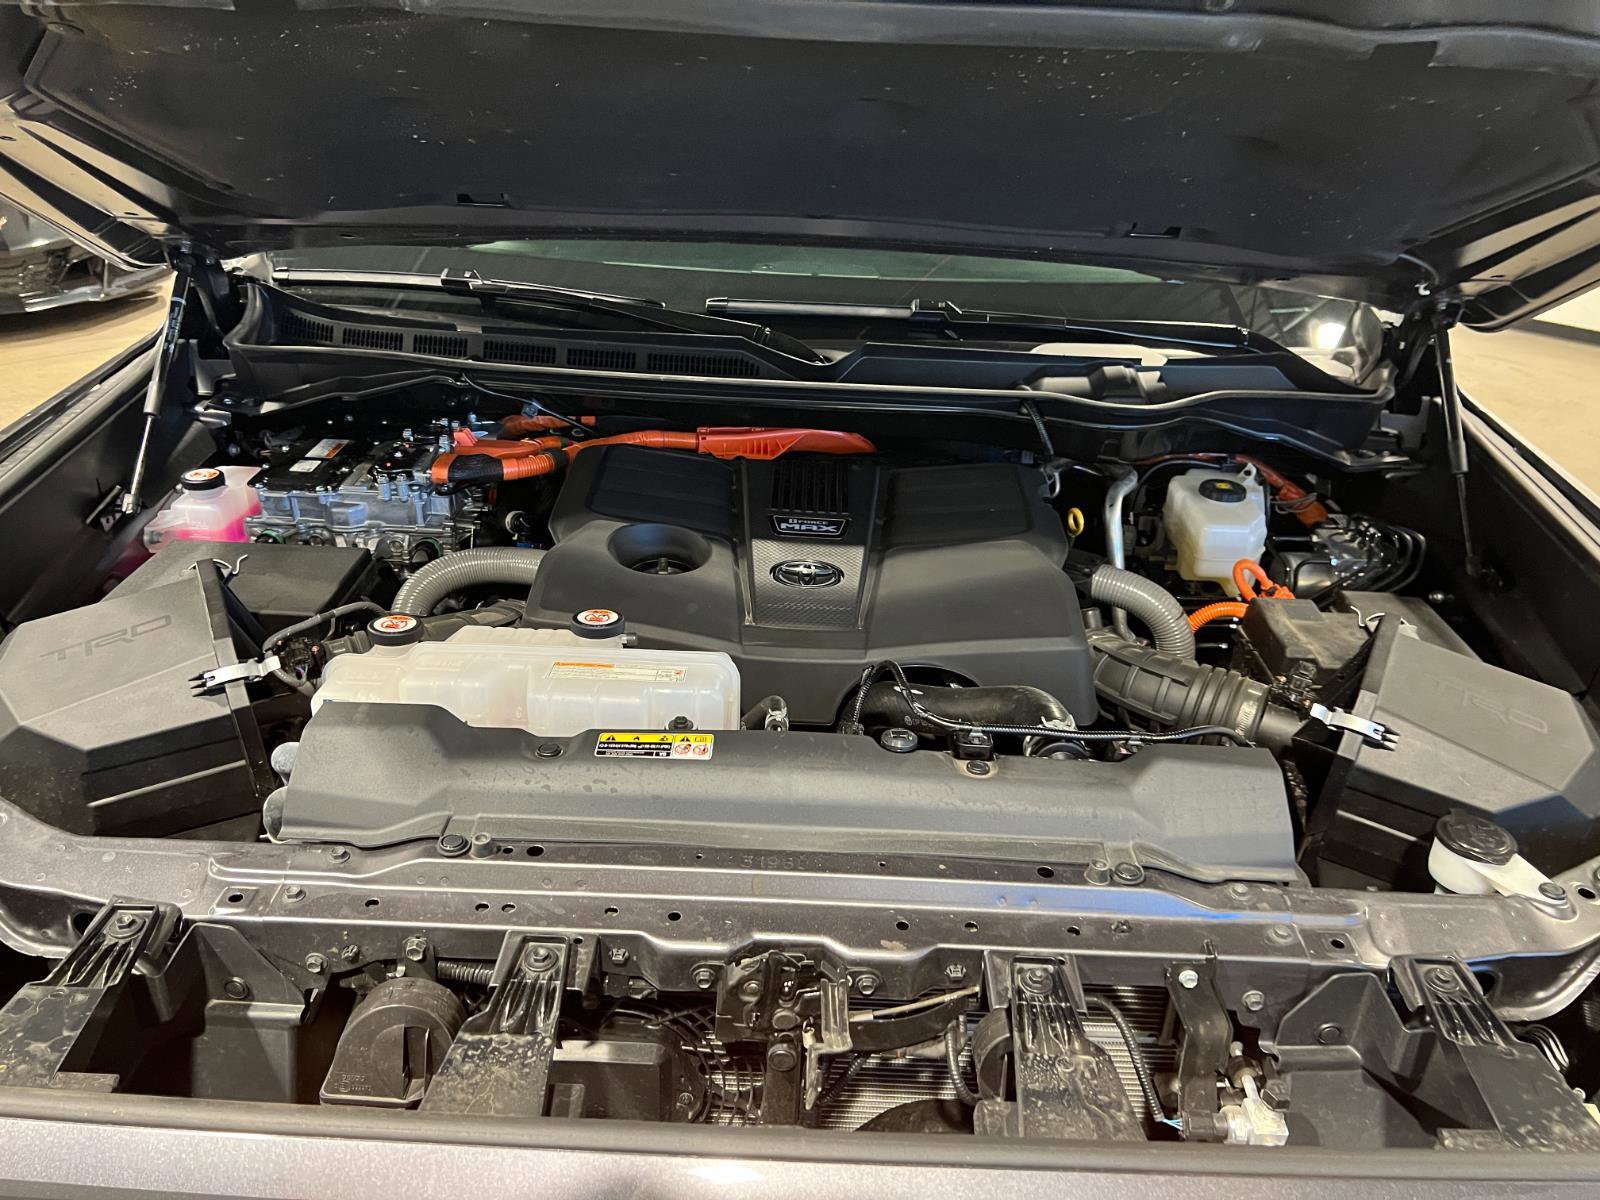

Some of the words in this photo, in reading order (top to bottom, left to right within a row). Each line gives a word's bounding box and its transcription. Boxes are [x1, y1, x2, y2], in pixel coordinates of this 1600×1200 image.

[780, 522, 838, 532] MAX
[39, 614, 172, 661] TRD
[1422, 672, 1549, 734] TRD
